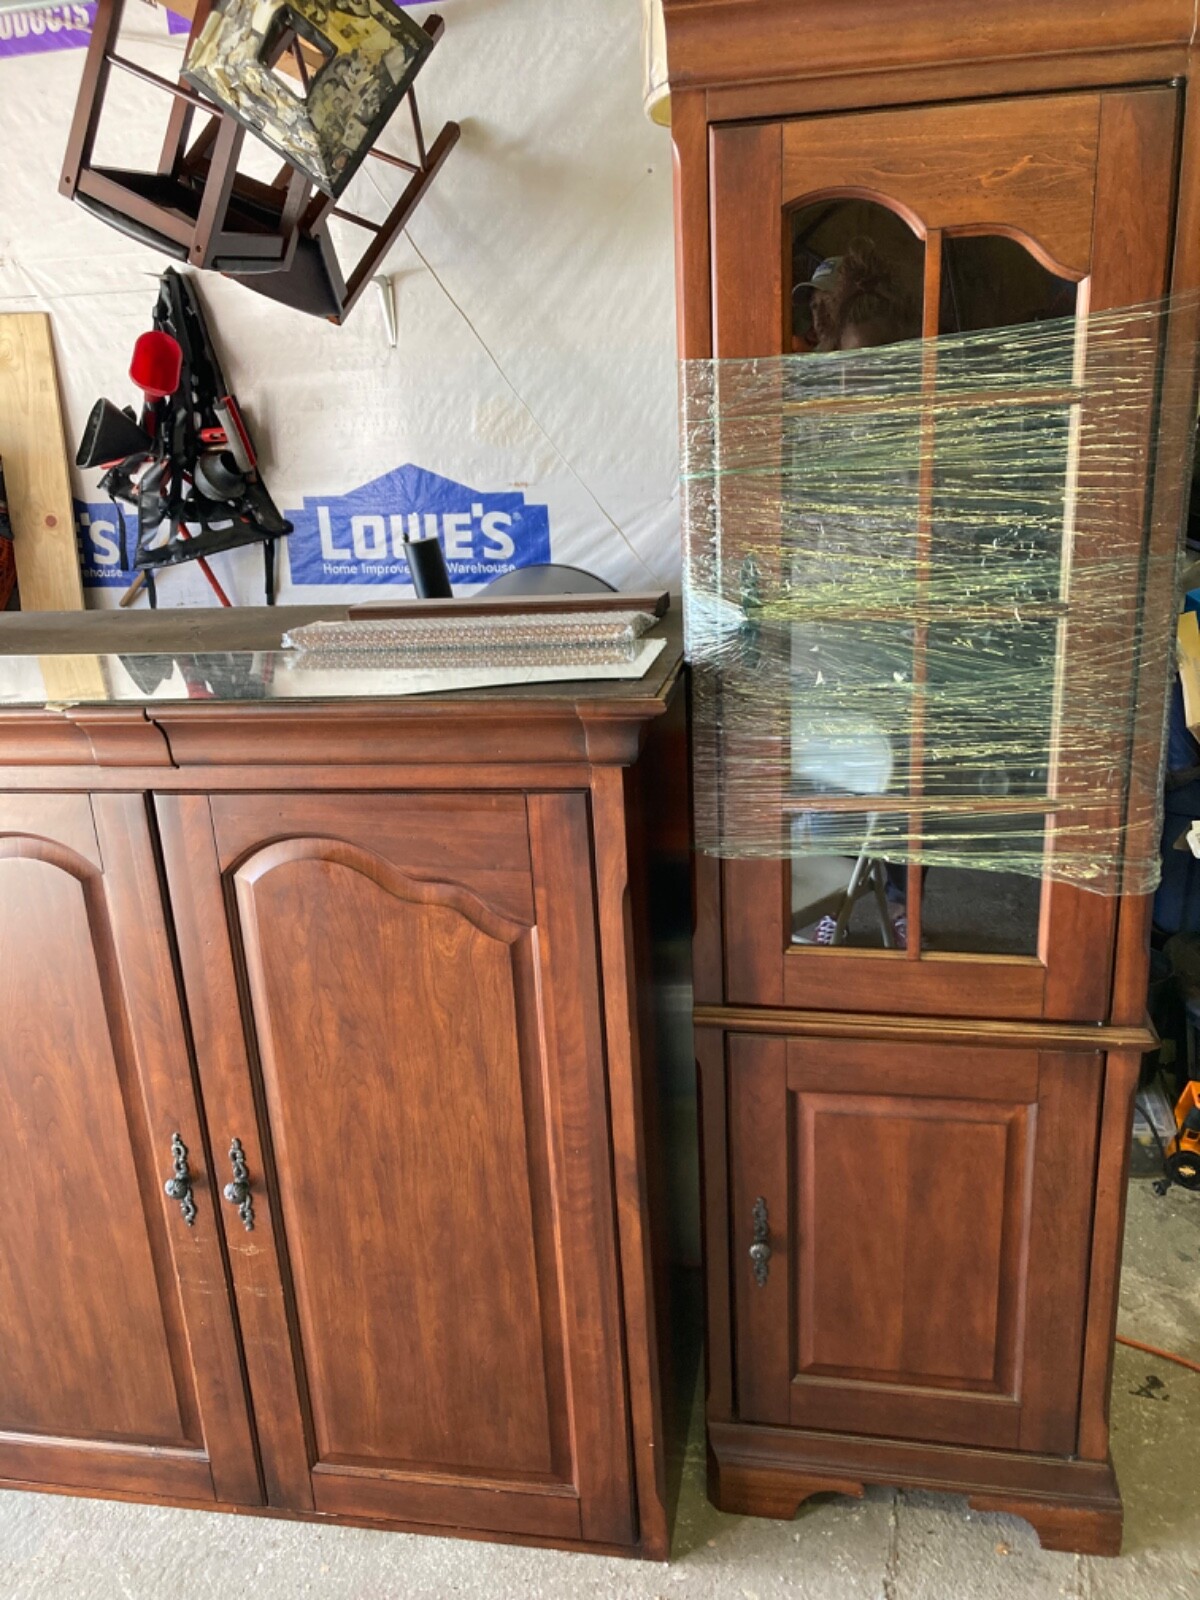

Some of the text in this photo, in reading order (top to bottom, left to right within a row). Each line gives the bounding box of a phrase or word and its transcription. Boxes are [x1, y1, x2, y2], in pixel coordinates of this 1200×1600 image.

[323, 562, 516, 576] Home Improve Warehouse
